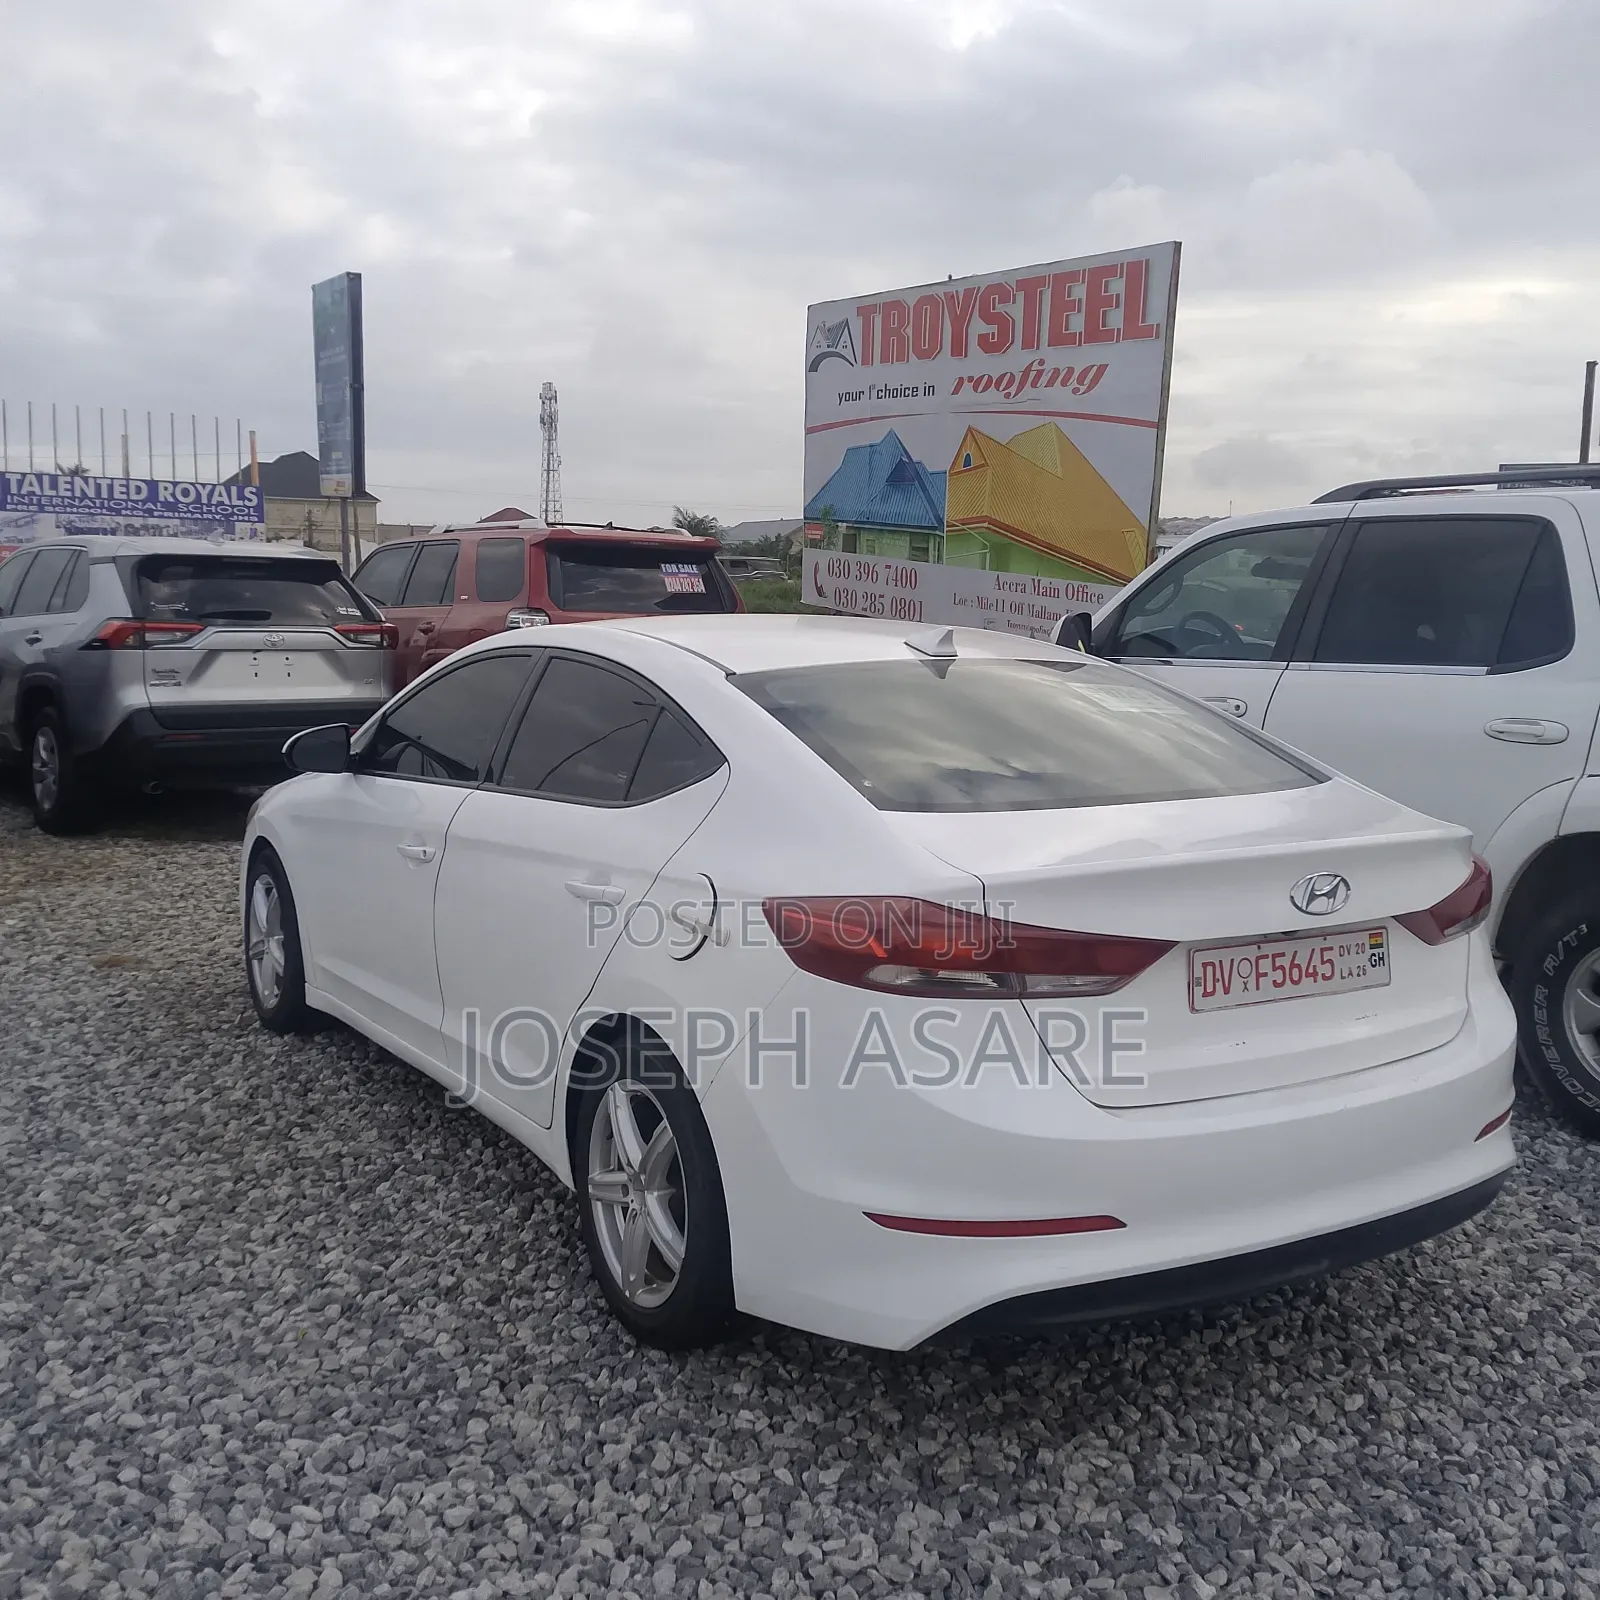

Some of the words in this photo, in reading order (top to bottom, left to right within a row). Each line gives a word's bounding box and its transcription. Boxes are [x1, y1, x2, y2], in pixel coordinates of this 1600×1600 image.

[856, 258, 1160, 367] TROYSTEEL
[951, 358, 1110, 400] roofing
[837, 390, 864, 406] your
[876, 383, 919, 400] choice
[923, 381, 935, 397] in
[5, 472, 148, 501] TALENTED
[157, 481, 259, 507] ROYALS
[6, 494, 166, 511] INTERNATIONAL
[178, 503, 259, 516] SCHOOL
[6, 504, 39, 512] PRE
[661, 563, 678, 573] FOR
[679, 564, 698, 574] SALE
[827, 557, 850, 580] 030
[855, 560, 879, 584] 396
[885, 564, 918, 590] 7400
[993, 573, 1027, 594] Accra
[1030, 577, 1060, 599] Main
[1065, 582, 1104, 605] Office
[834, 586, 858, 610] 030
[862, 591, 885, 615] 285
[890, 596, 924, 623] 0801
[1009, 601, 1026, 616] Off
[1338, 944, 1352, 957] DV
[1355, 942, 1366, 956] 20
[1370, 952, 1386, 968] GH
[1201, 957, 1235, 998] DV
[1255, 946, 1336, 991] F5645
[1340, 966, 1354, 980] LA
[1242, 980, 1249, 993] X
[1533, 985, 1600, 1113] COVERER
